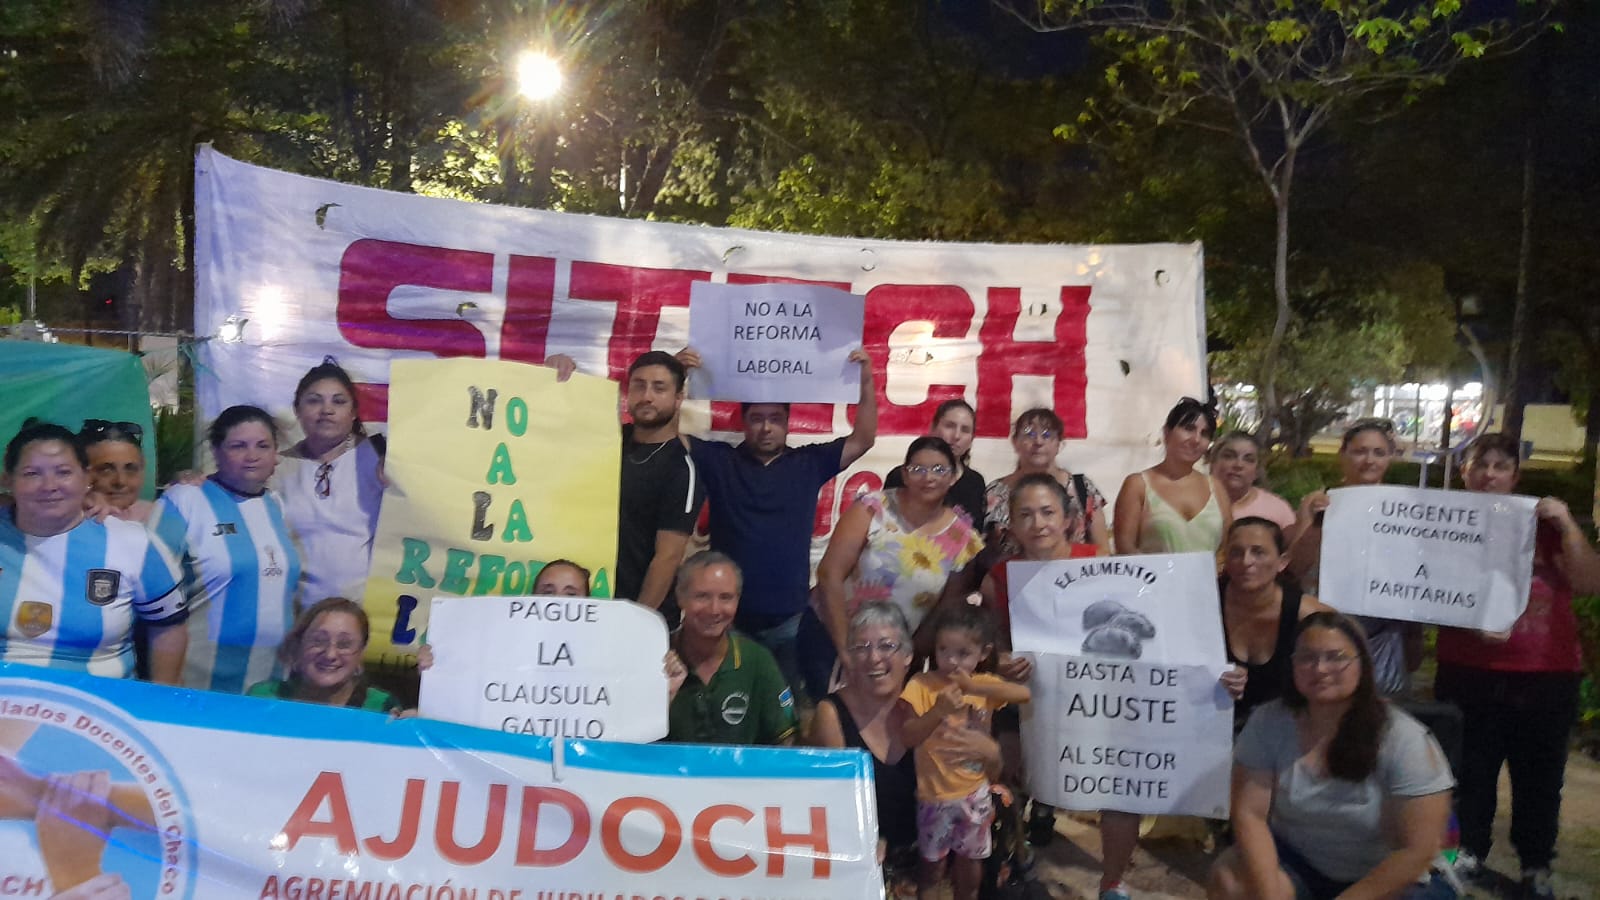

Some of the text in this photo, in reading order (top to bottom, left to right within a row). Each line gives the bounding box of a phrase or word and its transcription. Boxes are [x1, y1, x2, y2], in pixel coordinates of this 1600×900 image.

[745, 302, 813, 318] NO A LA
[336, 238, 1092, 439] SITCH
[734, 325, 822, 341] REFORMA
[737, 359, 813, 375] LABORAL
[466, 386, 528, 437] NO
[487, 442, 517, 486] A
[471, 491, 533, 543] LA
[1381, 501, 1480, 526] URGENTE
[1372, 522, 1484, 544] CONVOCATORIA
[1054, 562, 1157, 589] EL AUMENTO
[1414, 563, 1429, 580] A
[1369, 580, 1476, 609] PARITARIAS
[508, 601, 600, 624] PAGUE
[537, 641, 574, 666] LA
[1066, 661, 1178, 687] BASTA DE
[484, 682, 610, 706] CLAUSULA
[1067, 693, 1177, 724] AJUSTE
[502, 716, 605, 740] GATILLO
[73, 715, 157, 785] Docentes
[1059, 745, 1177, 771] AL SECTOR
[1063, 774, 1169, 799] DOCENTE
[154, 788, 178, 818] del
[267, 771, 831, 879] AJUDOCH
[162, 825, 182, 894] Chaco
